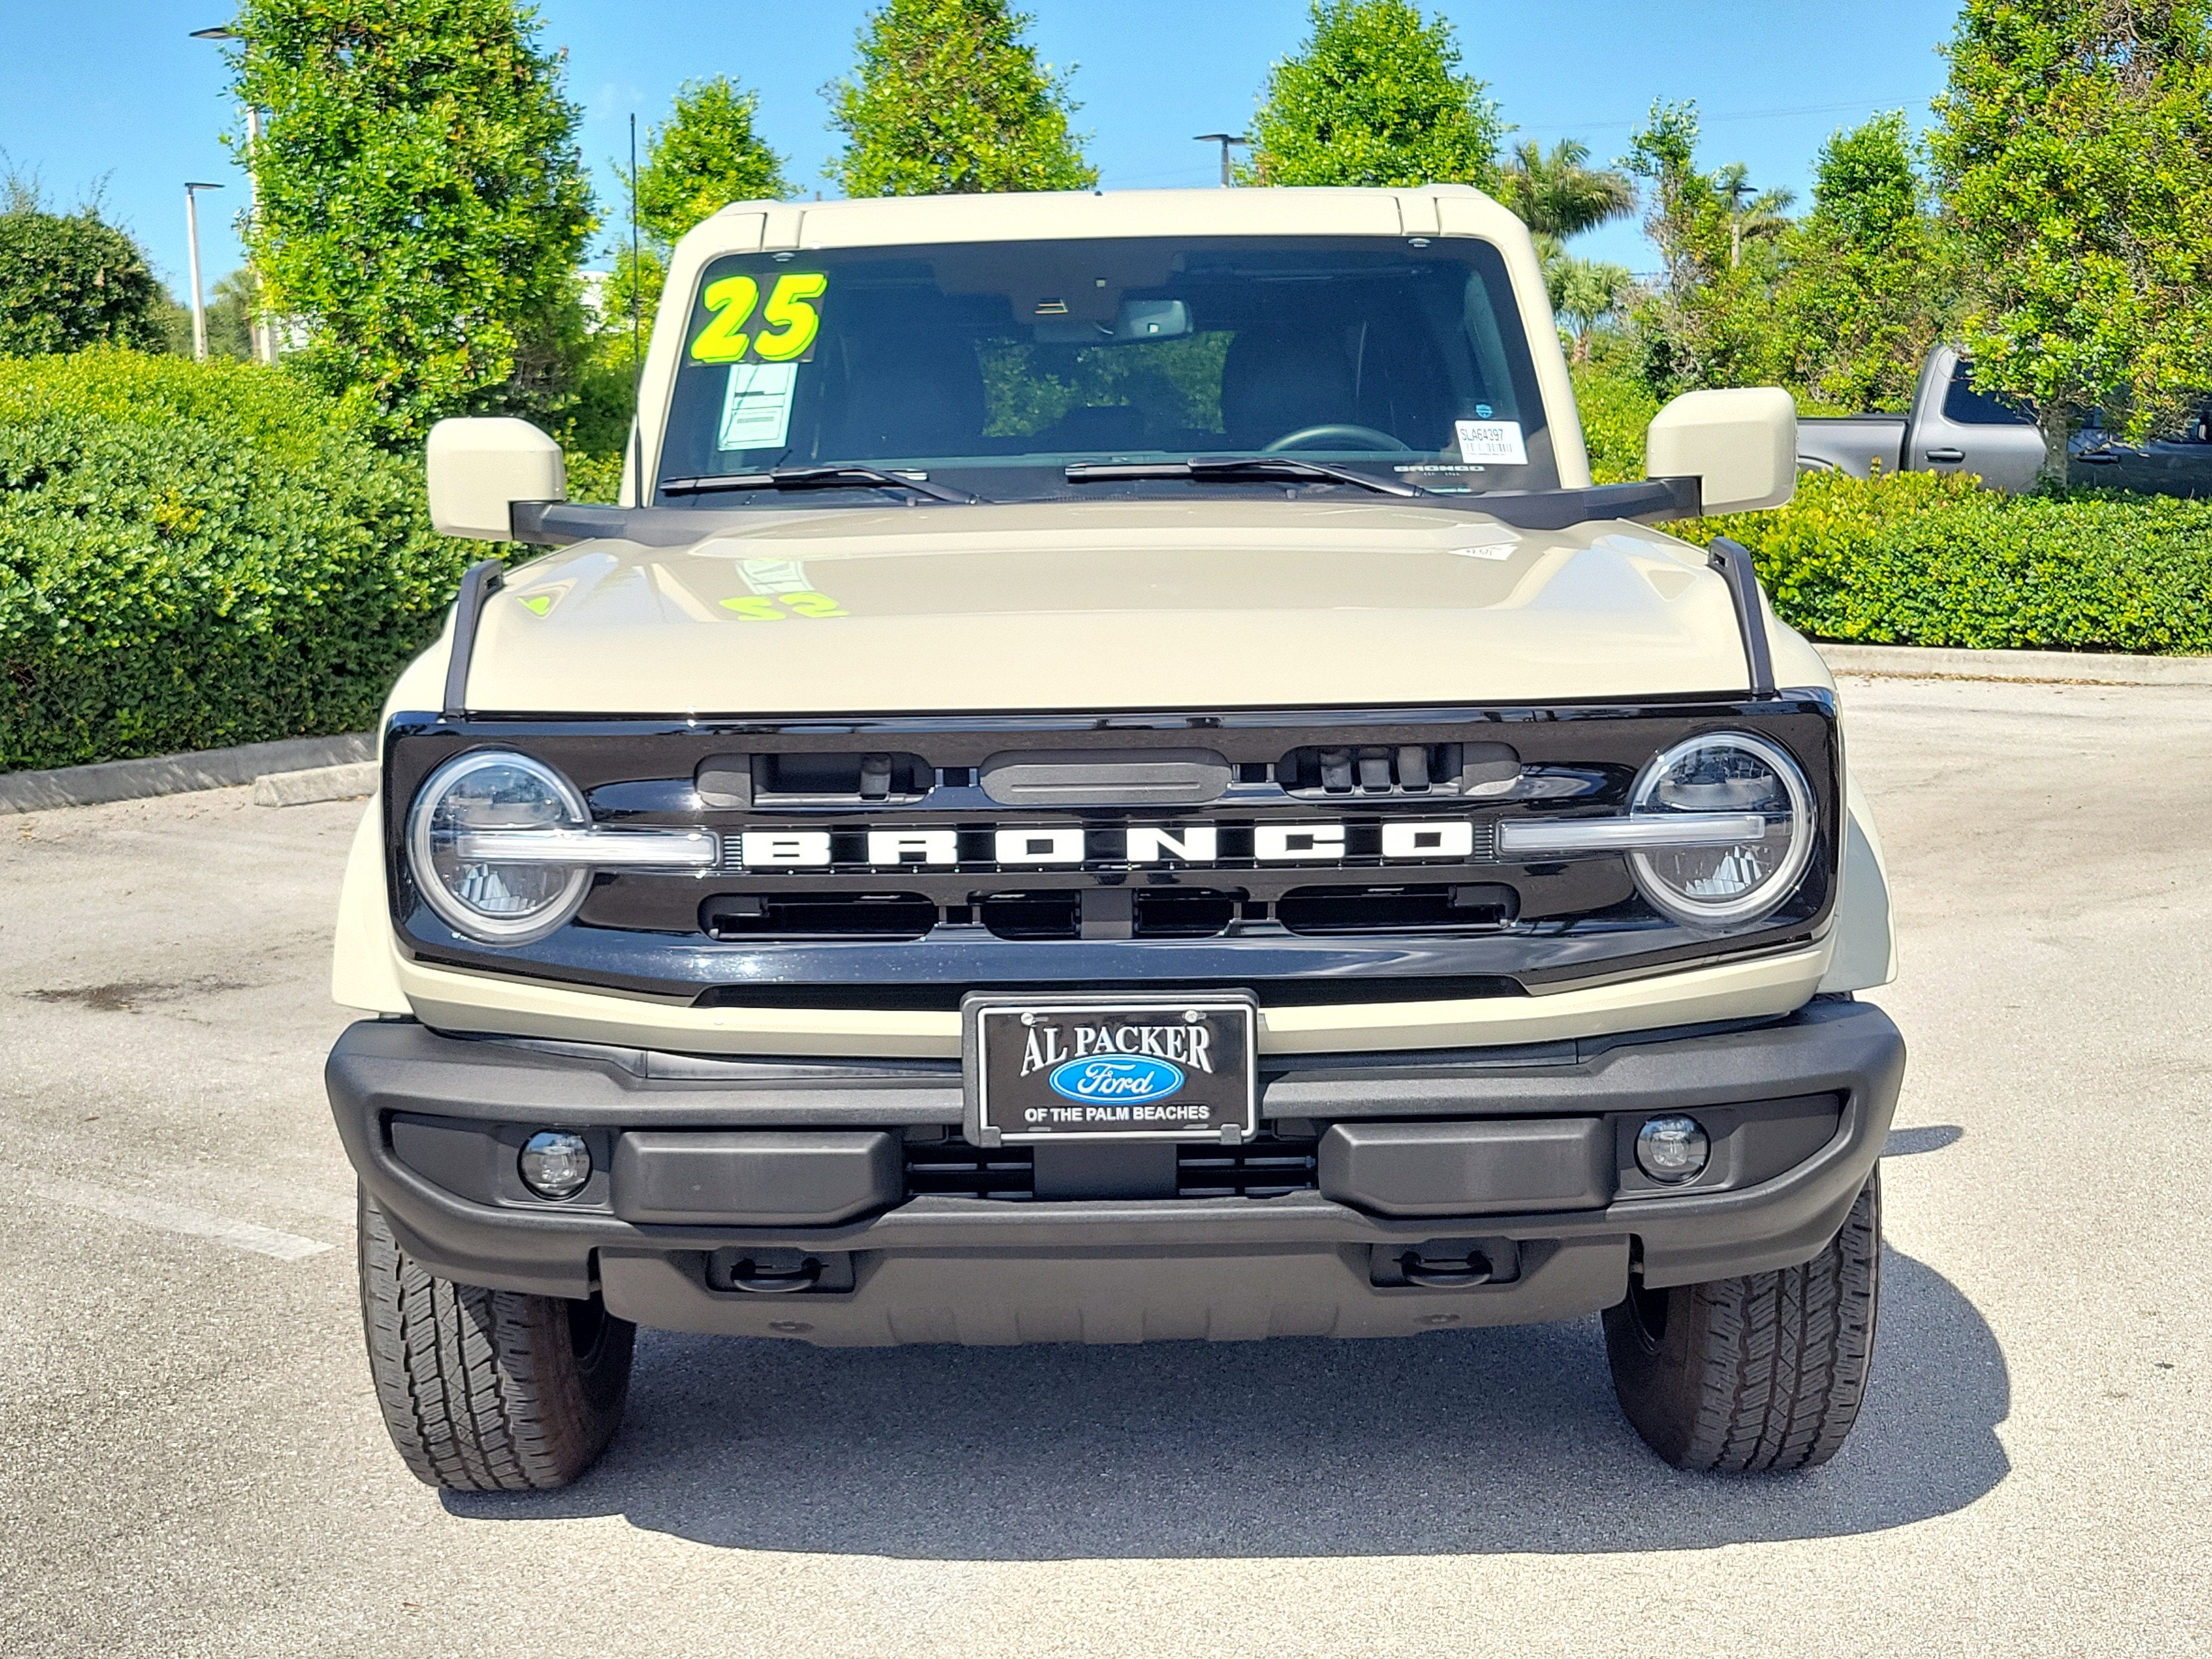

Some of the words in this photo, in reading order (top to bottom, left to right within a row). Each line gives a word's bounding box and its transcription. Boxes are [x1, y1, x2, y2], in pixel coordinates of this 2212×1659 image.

[691, 274, 828, 362] 25
[1460, 428, 1503, 441] SLA64397
[742, 822, 1473, 867] BRONCO
[1020, 1025, 1068, 1077] AL
[1074, 1025, 1214, 1074] PACKER
[1077, 1063, 1155, 1094] Ford
[1024, 1108, 1047, 1122] OF
[1051, 1107, 1084, 1122] THE
[1086, 1106, 1131, 1122] PALM
[1133, 1104, 1211, 1121] BEACHES
